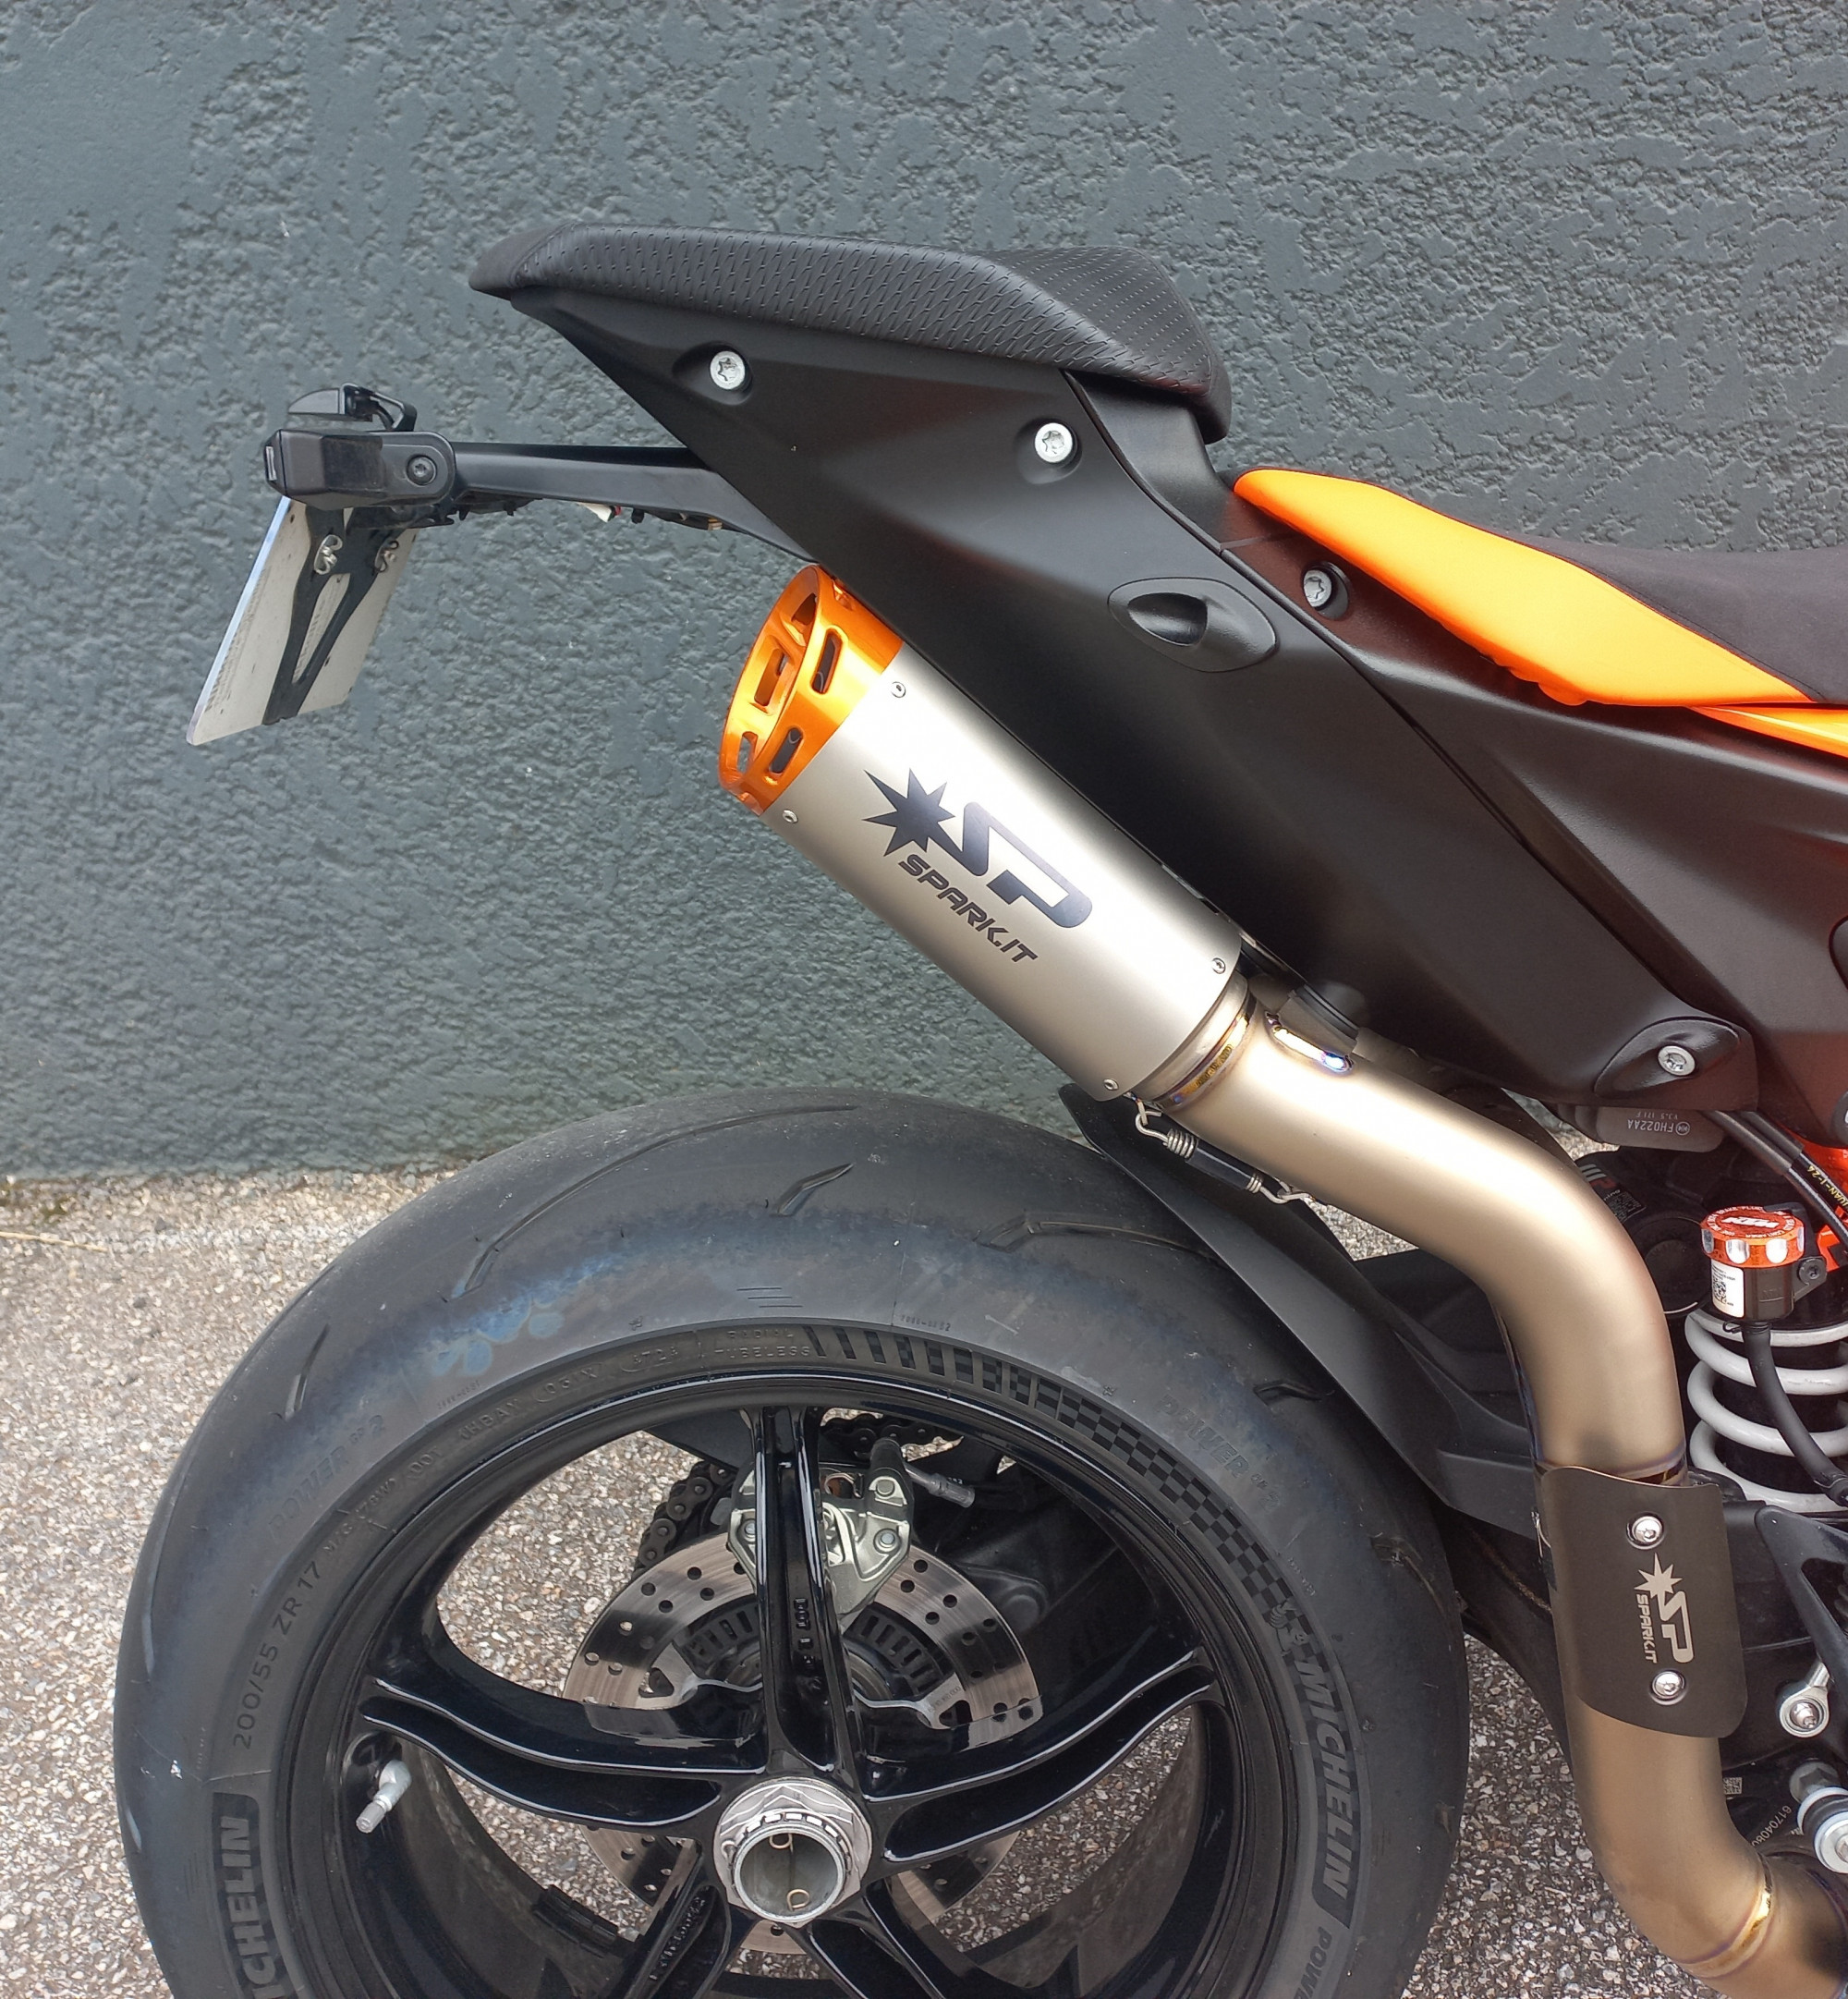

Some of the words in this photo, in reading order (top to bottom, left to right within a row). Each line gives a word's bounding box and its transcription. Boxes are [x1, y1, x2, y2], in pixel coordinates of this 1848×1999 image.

[897, 853, 1039, 963] SPARK.IT
[1627, 1119, 1674, 1133] FH022AA
[713, 1345, 812, 1359] TUBELESS
[232, 1641, 279, 1750] 200/55
[272, 1595, 303, 1636] ZR
[297, 1559, 322, 1590] 17
[1294, 1658, 1354, 1905] MICHELIN
